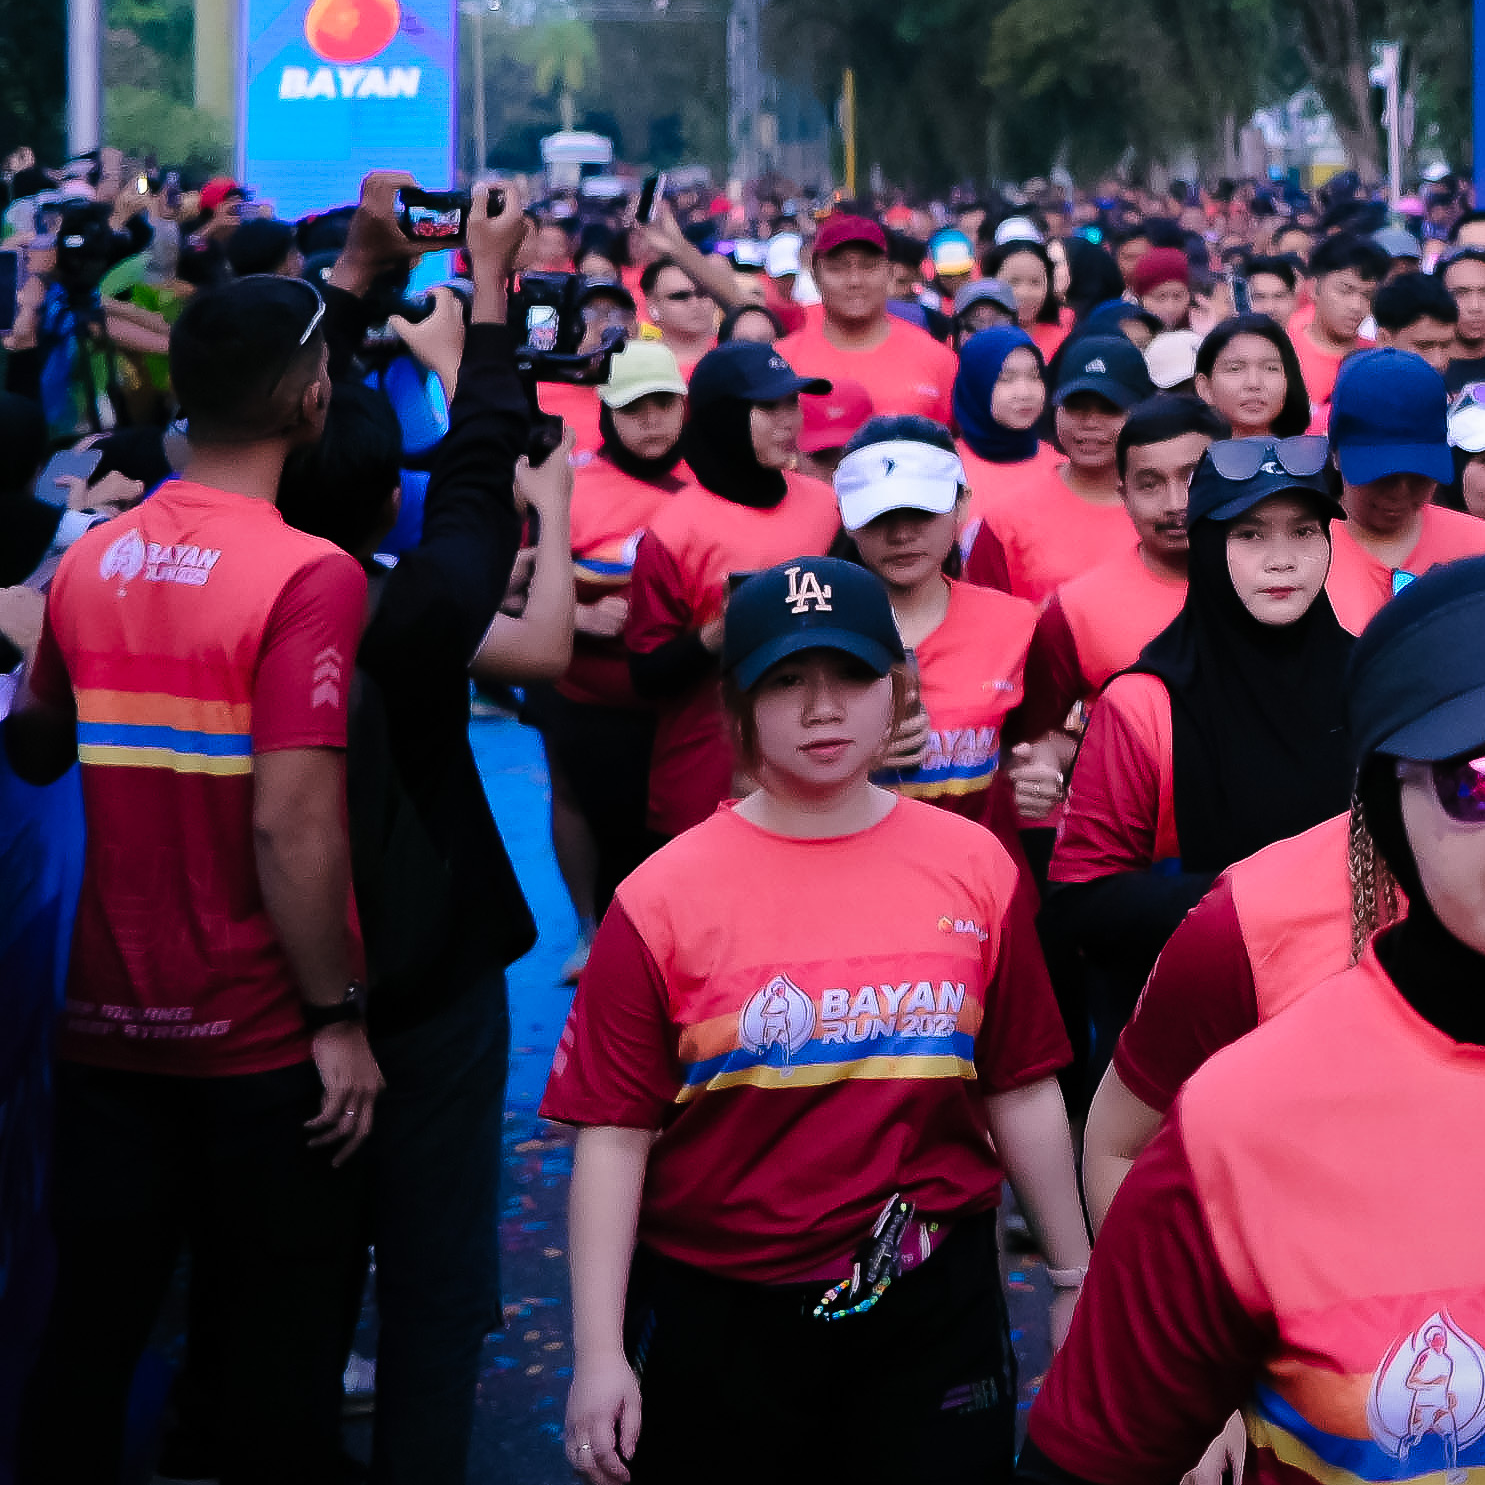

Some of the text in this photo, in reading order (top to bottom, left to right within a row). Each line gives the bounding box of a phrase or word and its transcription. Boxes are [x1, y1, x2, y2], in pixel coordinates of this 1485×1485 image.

[278, 66, 421, 100] BAYAN
[146, 541, 223, 571] BAYAN
[784, 566, 833, 615] LA
[925, 727, 997, 757] AYAN
[819, 980, 967, 1017] BAYAN
[821, 1011, 957, 1046] RUN 2025
